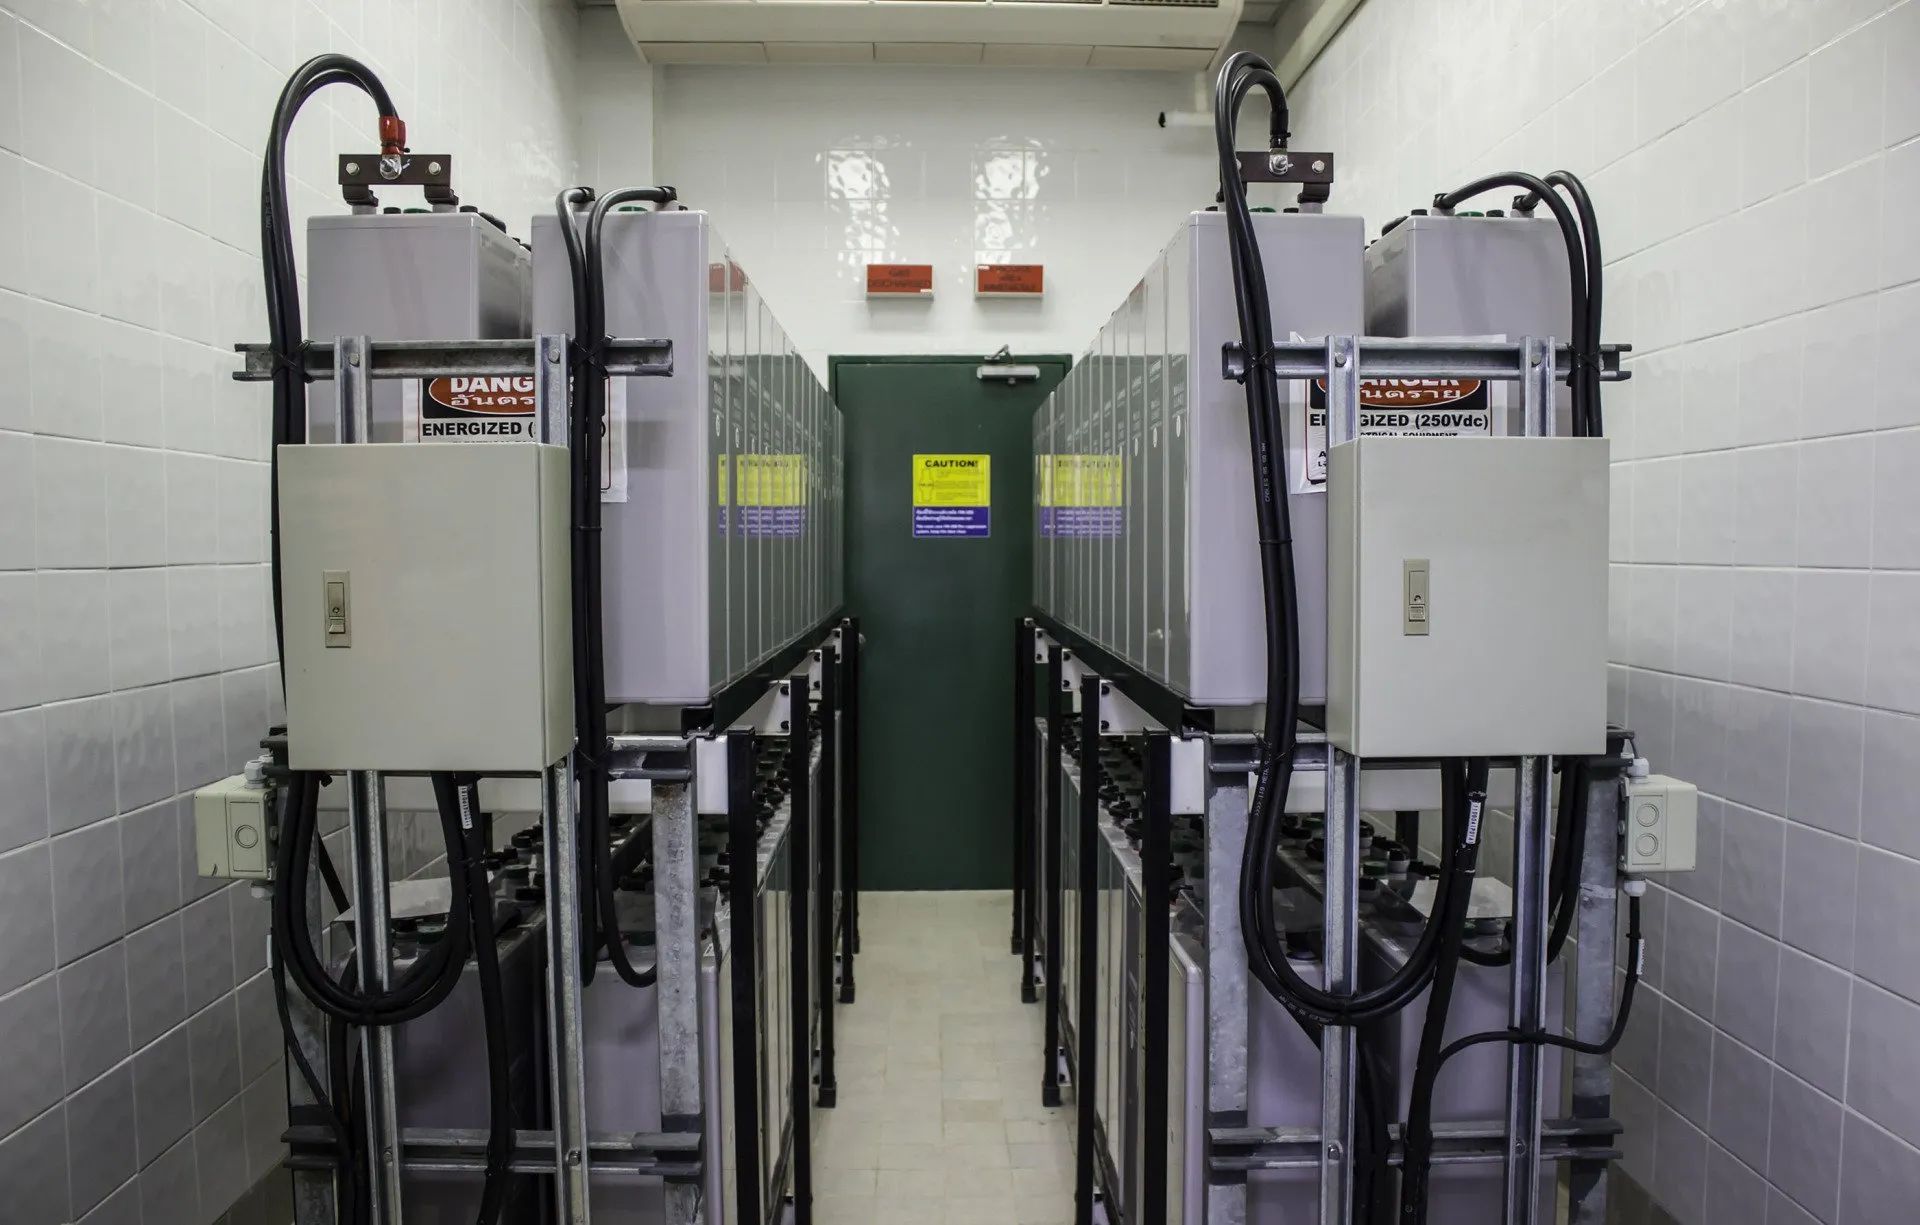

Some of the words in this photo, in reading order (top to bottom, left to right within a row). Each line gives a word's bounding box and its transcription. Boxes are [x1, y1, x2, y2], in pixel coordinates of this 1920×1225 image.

[450, 376, 534, 393] DANG
[422, 422, 522, 436] ENERGIZED
[1415, 414, 1488, 430] (250Vdc)
